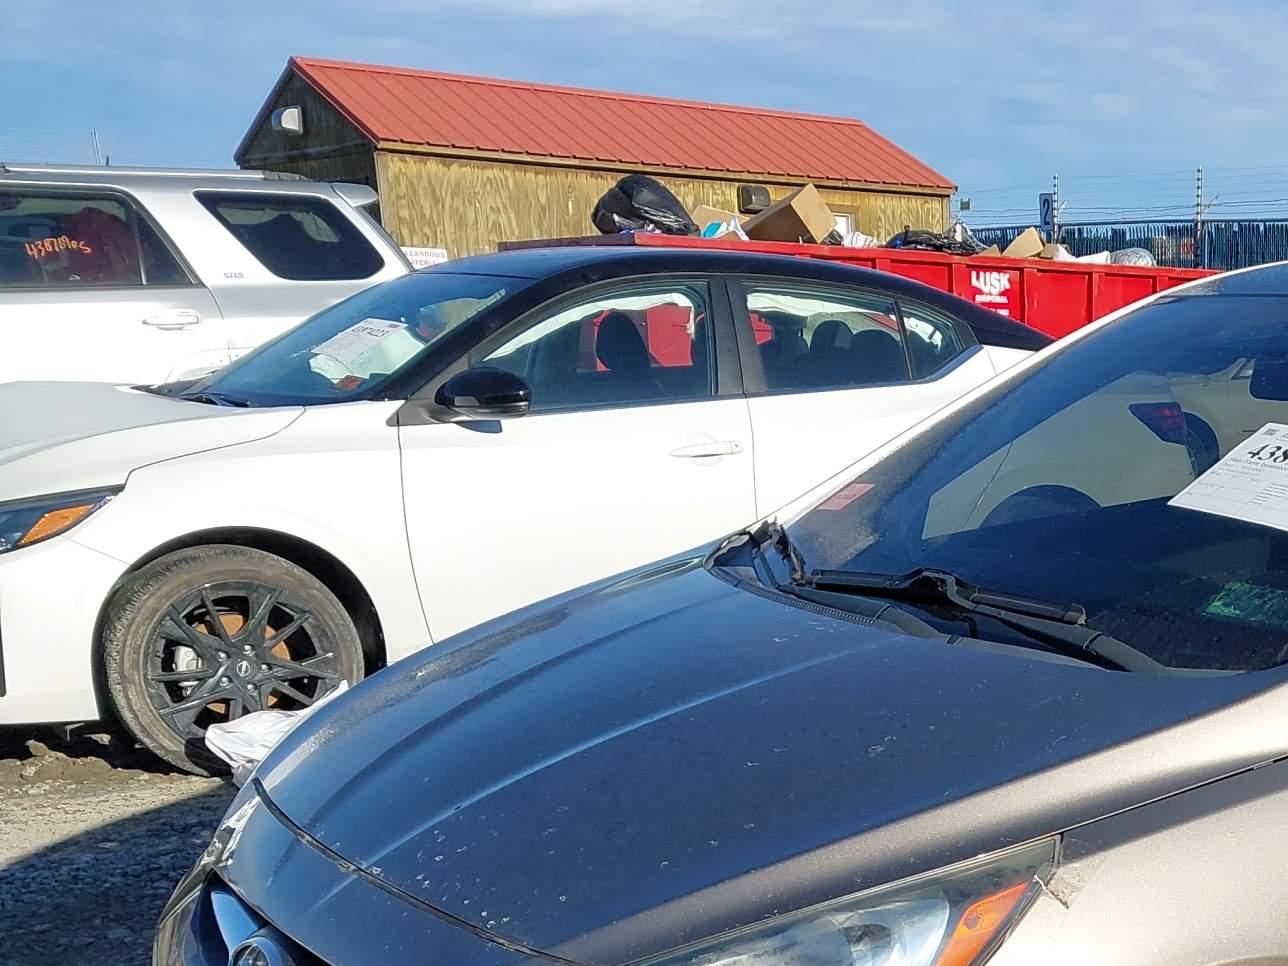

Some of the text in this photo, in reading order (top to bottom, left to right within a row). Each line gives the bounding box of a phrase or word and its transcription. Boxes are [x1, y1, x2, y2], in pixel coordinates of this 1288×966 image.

[1042, 198, 1050, 225] 2
[404, 250, 446, 258] AZARDOUS
[971, 270, 1011, 295] LUSK
